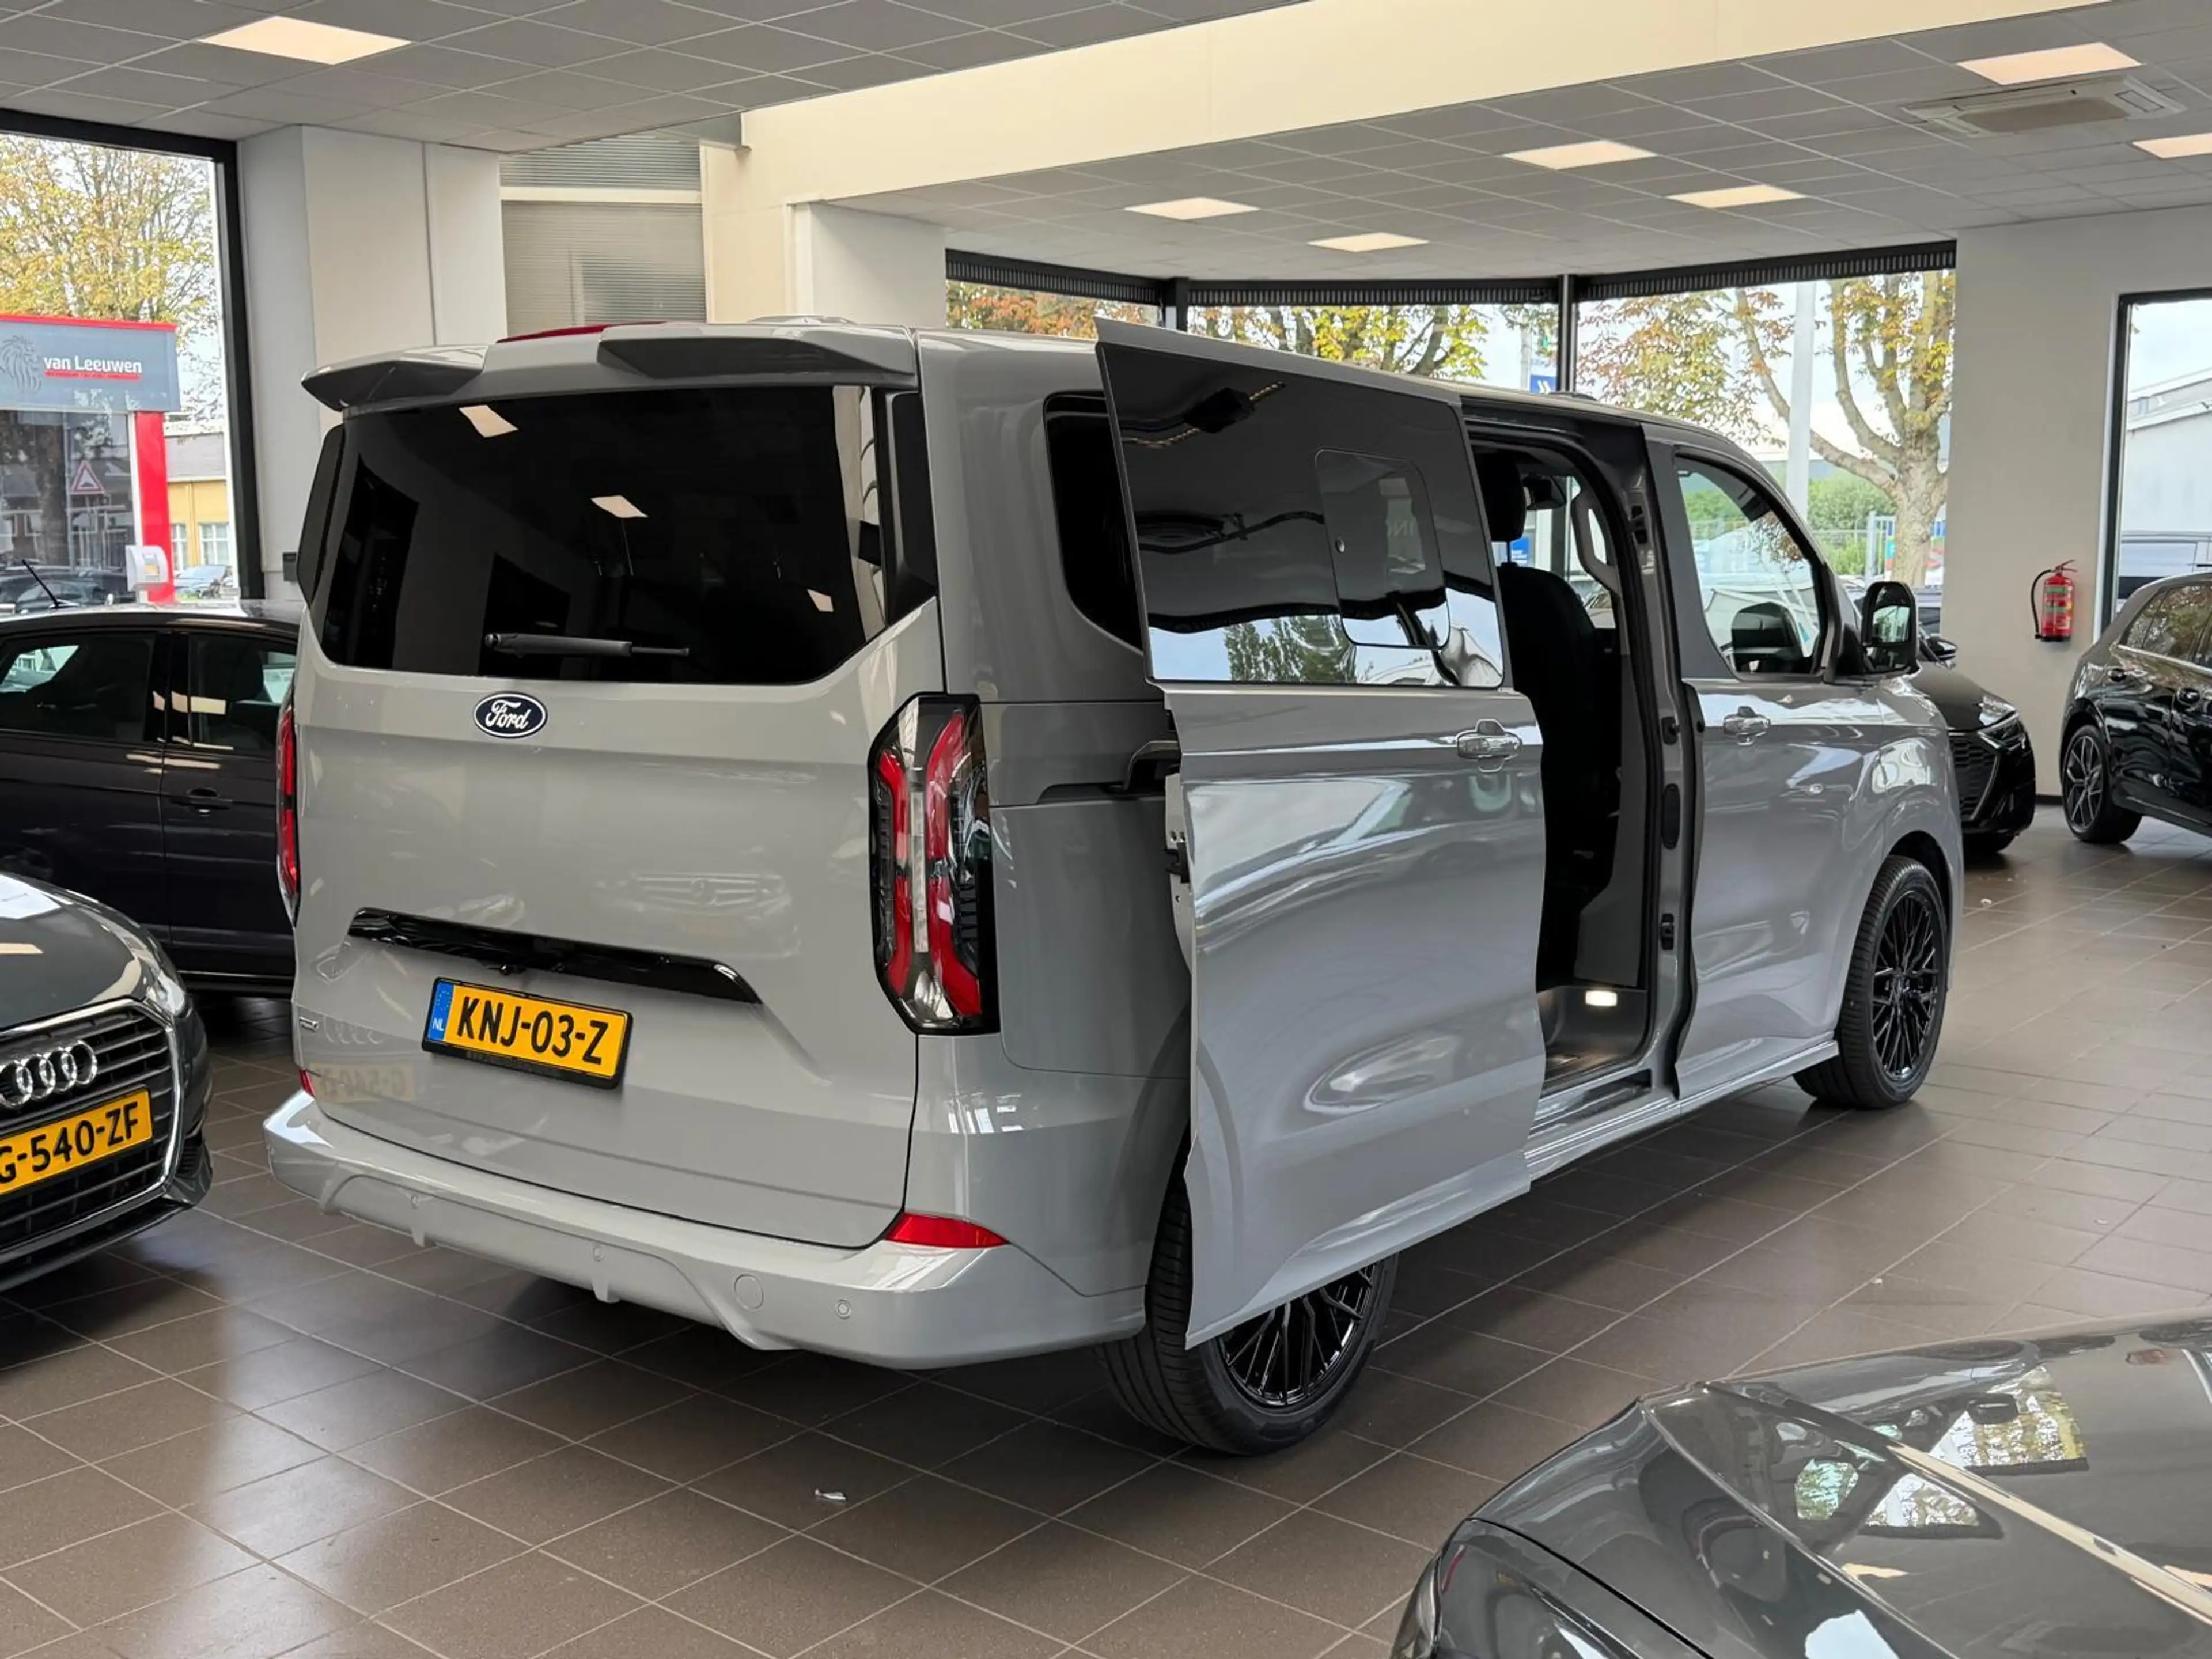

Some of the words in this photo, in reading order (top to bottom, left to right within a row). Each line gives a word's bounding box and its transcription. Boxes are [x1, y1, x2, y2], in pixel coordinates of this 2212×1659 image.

[43, 356, 72, 370] van
[74, 355, 142, 373] Leeuwen
[486, 699, 531, 729] Ford
[433, 1017, 444, 1031] NL
[457, 995, 609, 1066] KNJ-03-Z
[0, 1101, 138, 1184] G-540-ZF
